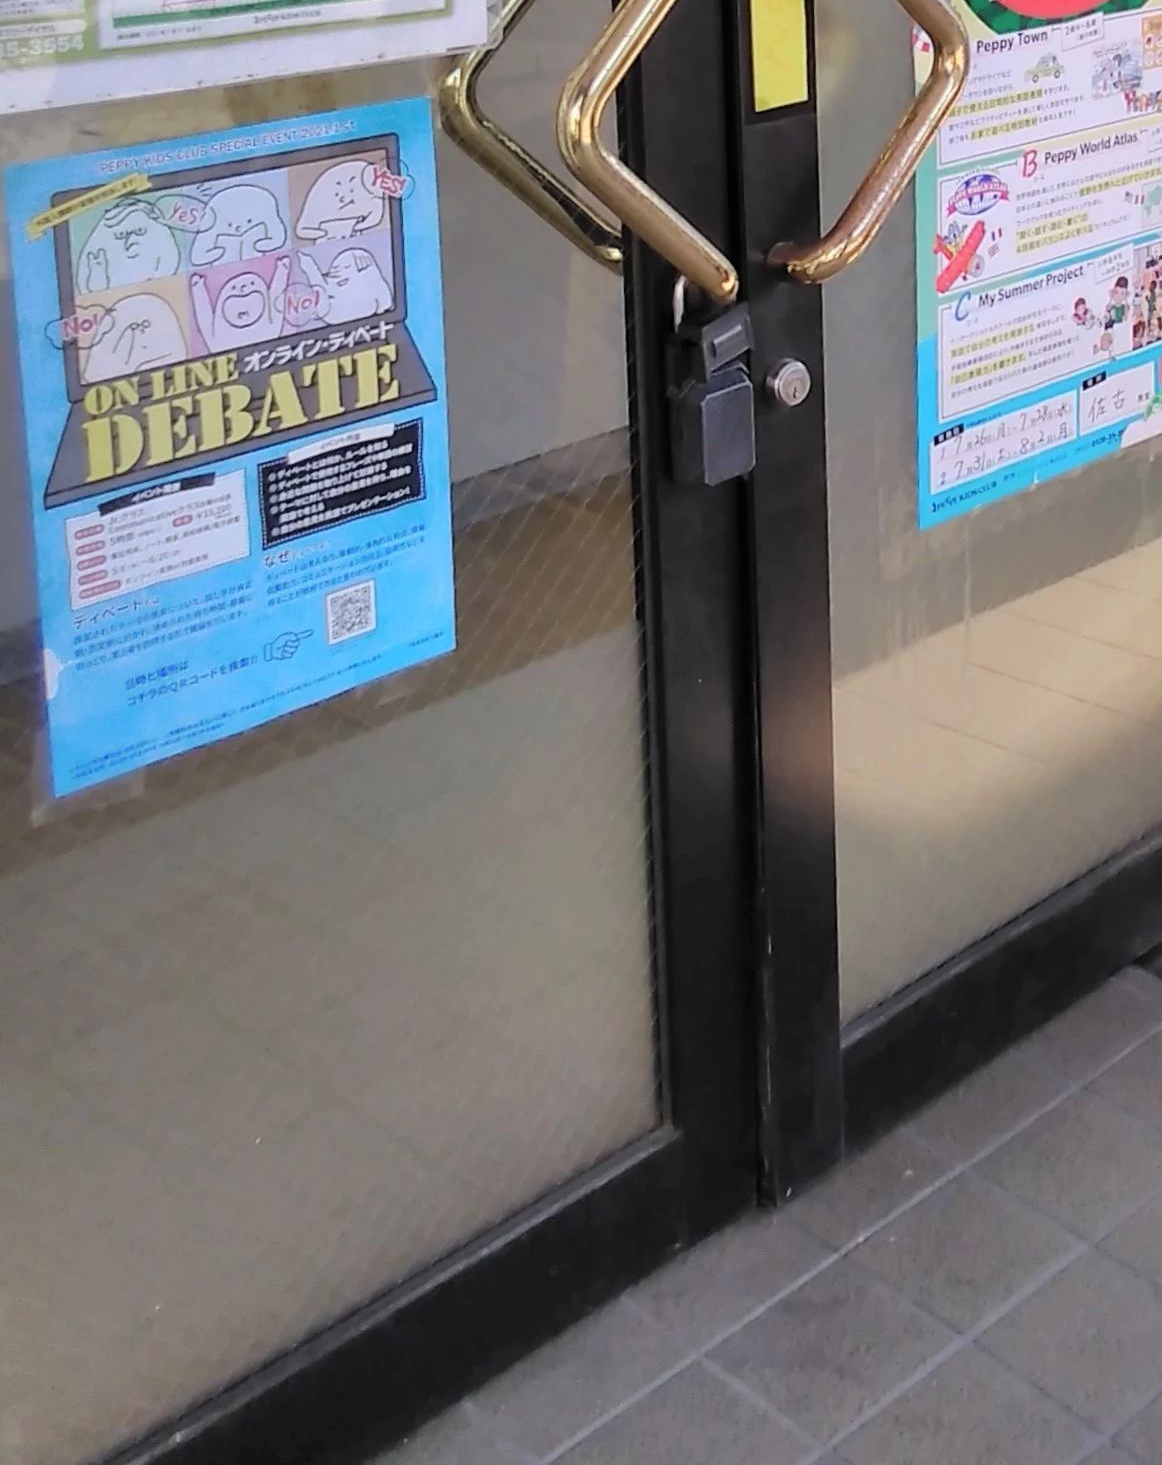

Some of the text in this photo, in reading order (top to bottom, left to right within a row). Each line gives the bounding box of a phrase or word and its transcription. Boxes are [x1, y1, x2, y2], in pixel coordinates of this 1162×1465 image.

[0, 34, 84, 56] 5-3554
[976, 29, 1049, 54] Peppy Town
[100, 159, 139, 174] PEPPY
[144, 152, 173, 168] KIDS
[176, 147, 207, 162] CLUB
[211, 137, 258, 154] SPECIAL
[262, 130, 297, 146] EVENT
[1044, 131, 1138, 165] Peppy World Atlas
[1022, 149, 1038, 178] B
[372, 166, 407, 195] YES!
[978, 265, 1085, 309] My Summer Project
[287, 293, 320, 315] No!
[955, 292, 972, 322] C
[62, 315, 100, 337] No!
[84, 353, 241, 416] ON LINE
[82, 343, 400, 482] DEBATE
